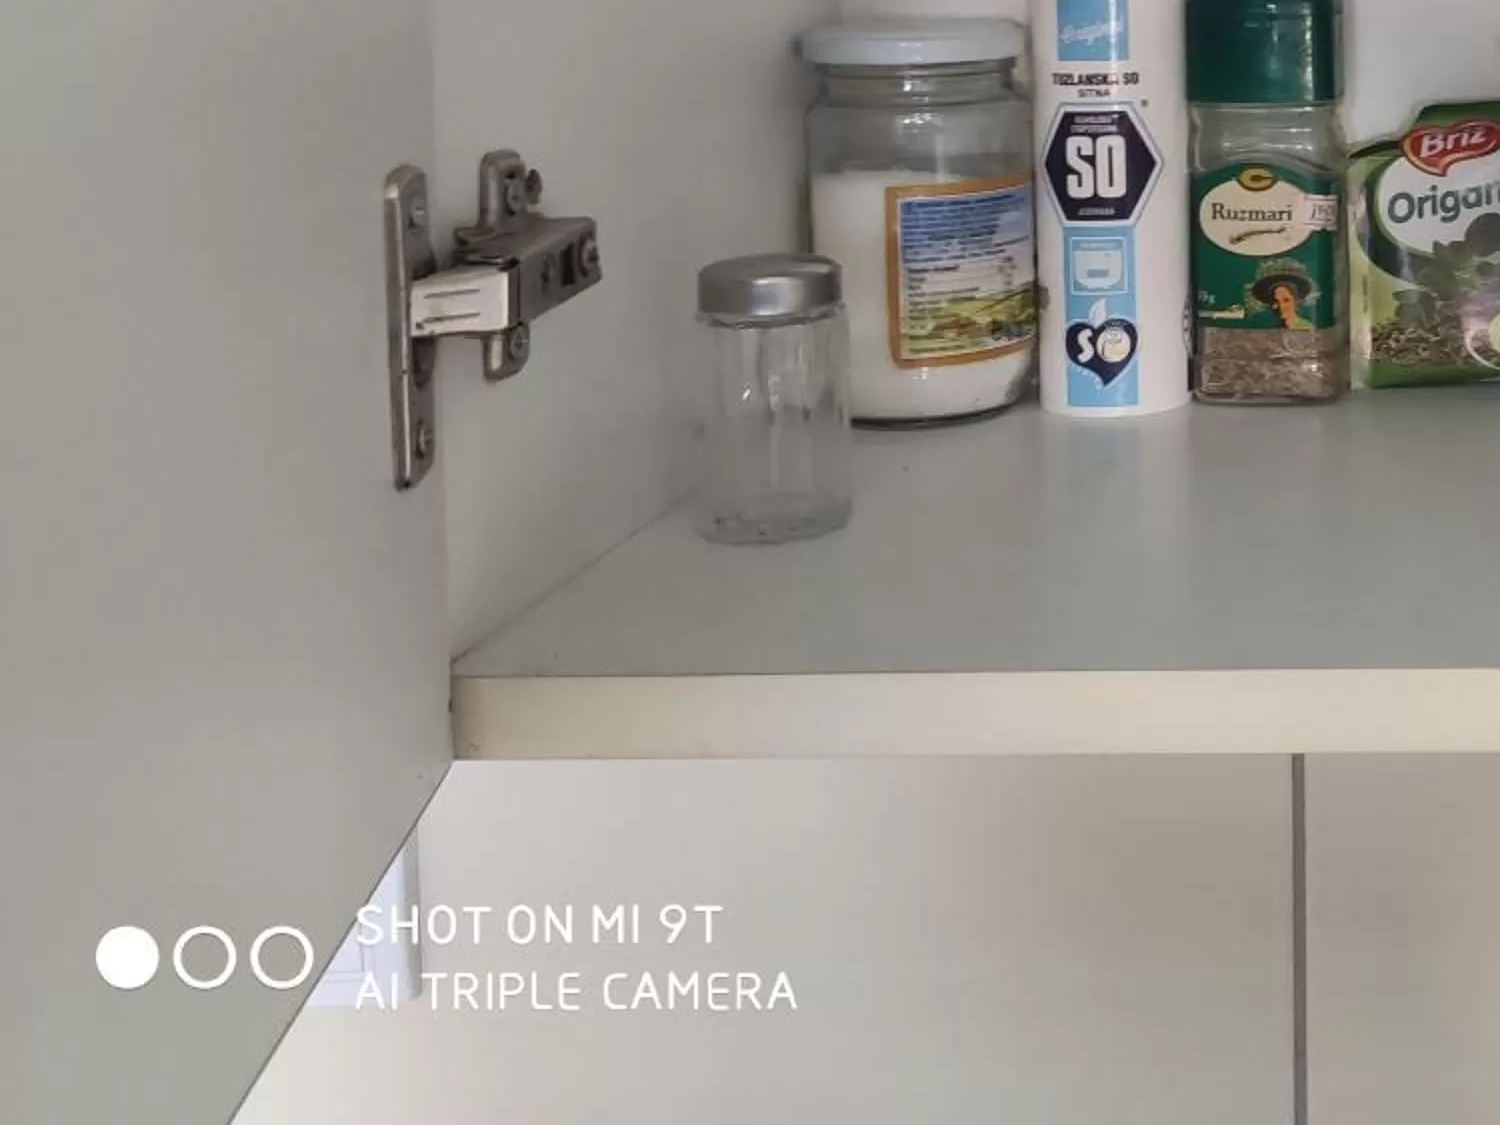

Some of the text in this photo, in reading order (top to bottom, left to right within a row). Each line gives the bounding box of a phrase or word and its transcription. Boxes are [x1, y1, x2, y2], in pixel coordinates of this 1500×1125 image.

[1419, 126, 1488, 158] Briz
[1065, 135, 1127, 199] SO
[1211, 202, 1293, 222] Ruzmari
